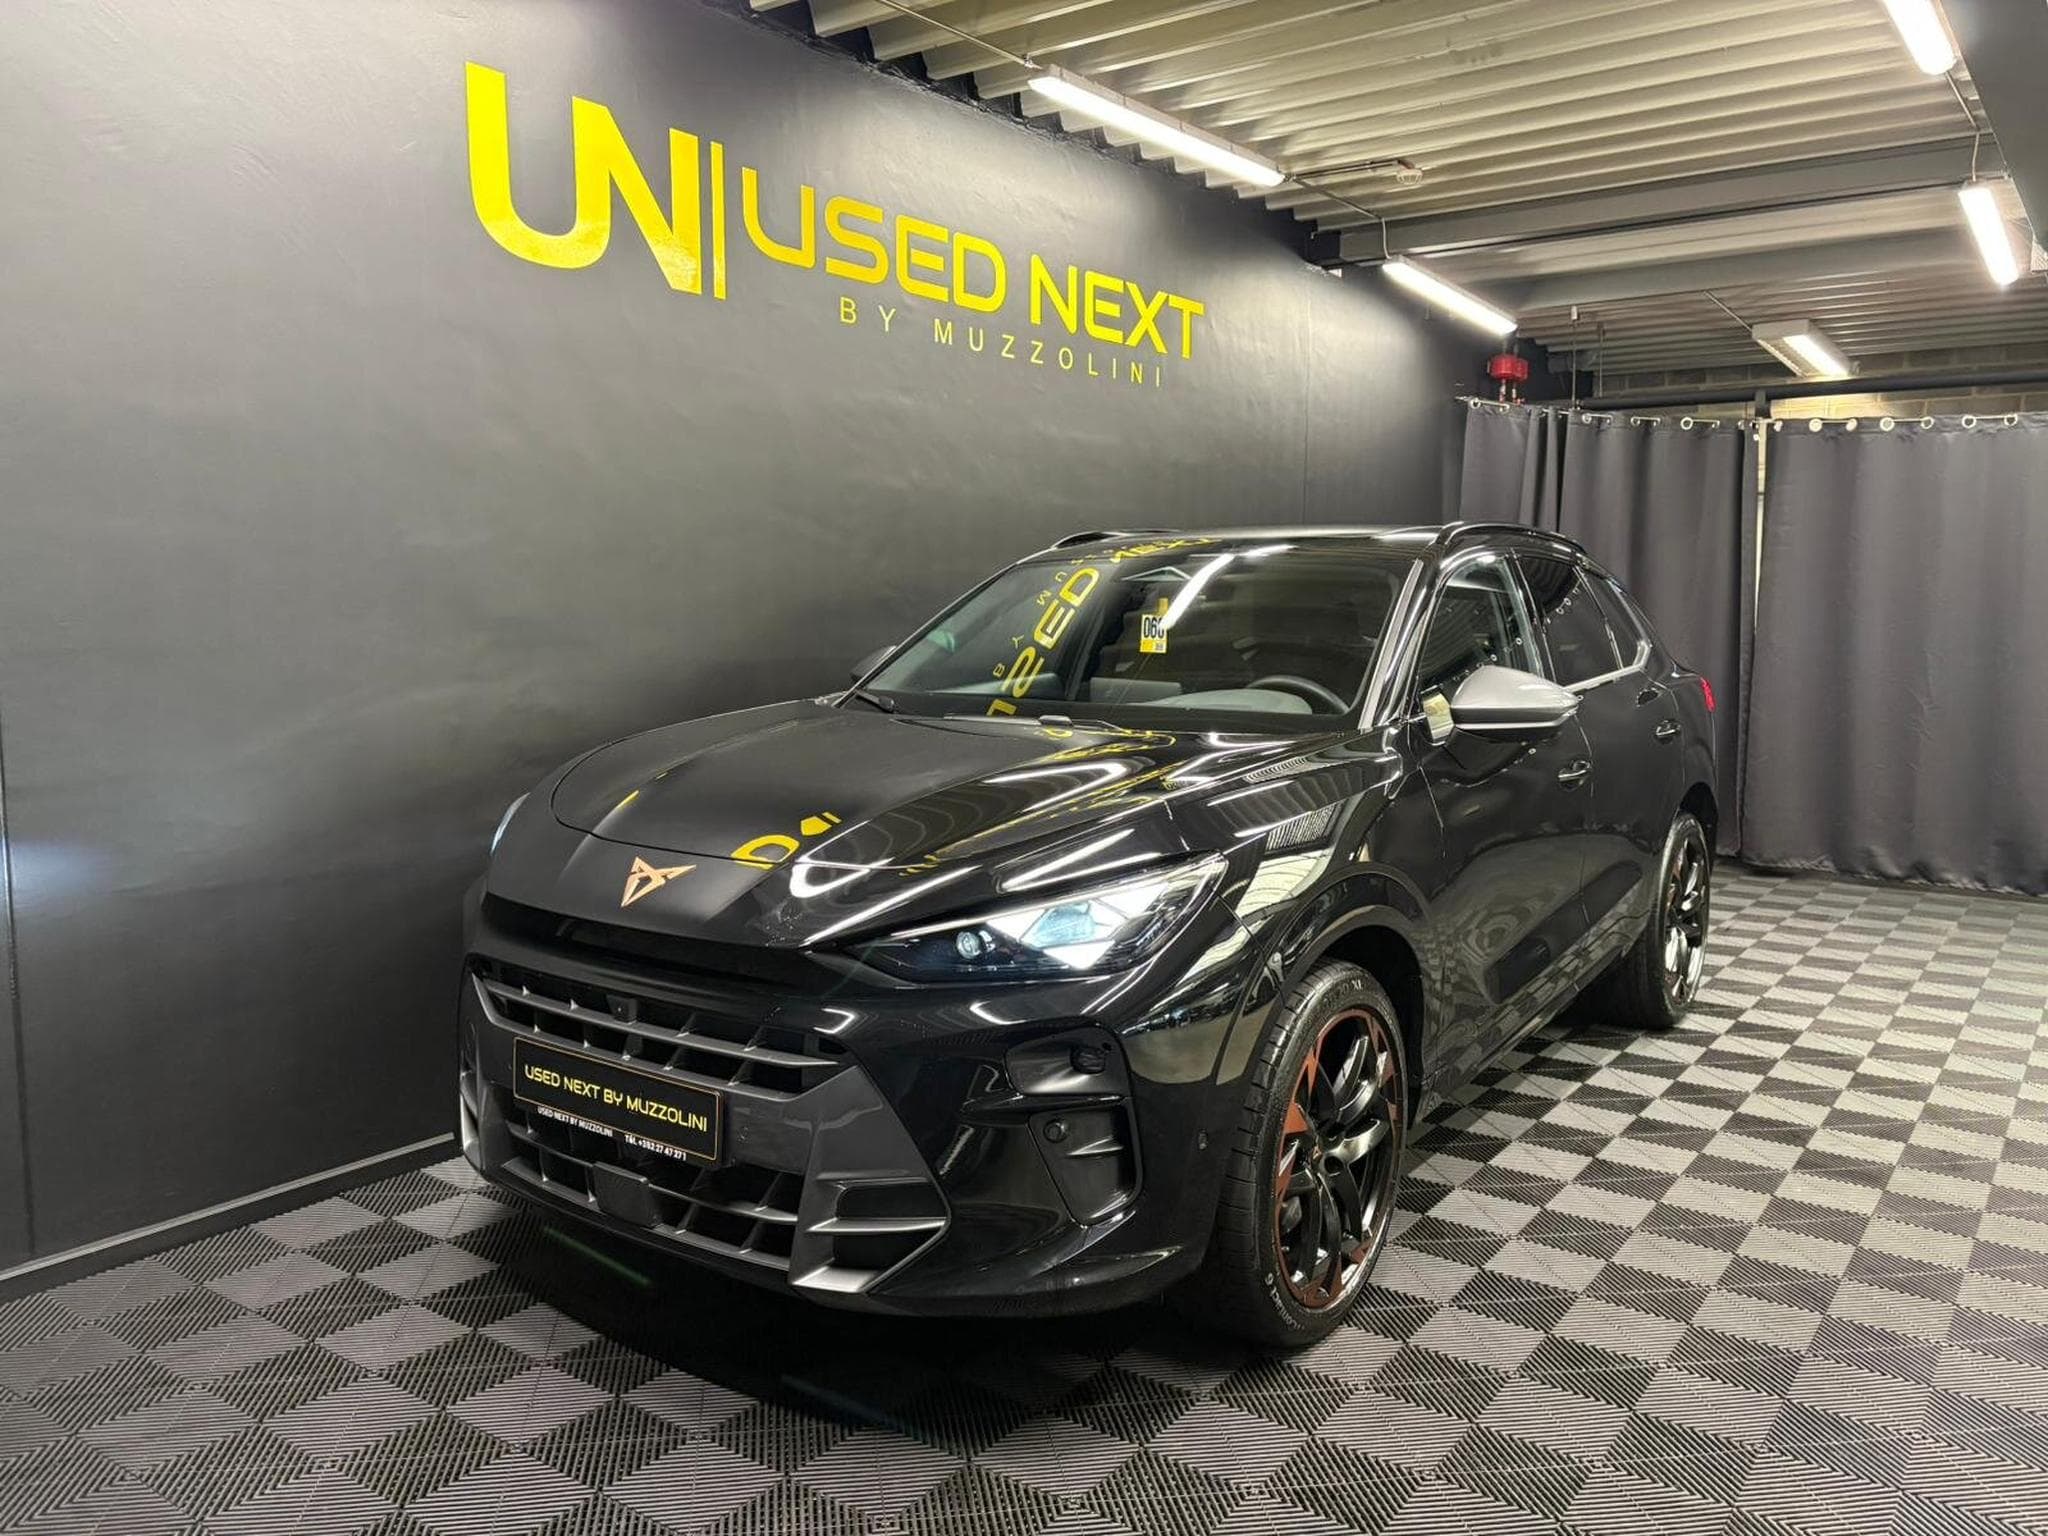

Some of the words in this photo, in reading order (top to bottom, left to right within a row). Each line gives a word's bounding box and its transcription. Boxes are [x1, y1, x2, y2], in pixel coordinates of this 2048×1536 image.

[741, 167, 1008, 314] USED
[1029, 255, 1206, 360] NEXT
[839, 296, 896, 333] BY
[933, 318, 1161, 388] MUZZOLINI
[524, 1064, 561, 1088] USED
[563, 1076, 601, 1100] NEXT
[603, 1087, 624, 1107] BY
[626, 1095, 708, 1133] MUZZOLINI
[537, 1105, 554, 1118] USED
[554, 1111, 570, 1123] NEXT
[570, 1117, 578, 1126] BY
[578, 1119, 613, 1138] MUZZOLINI
